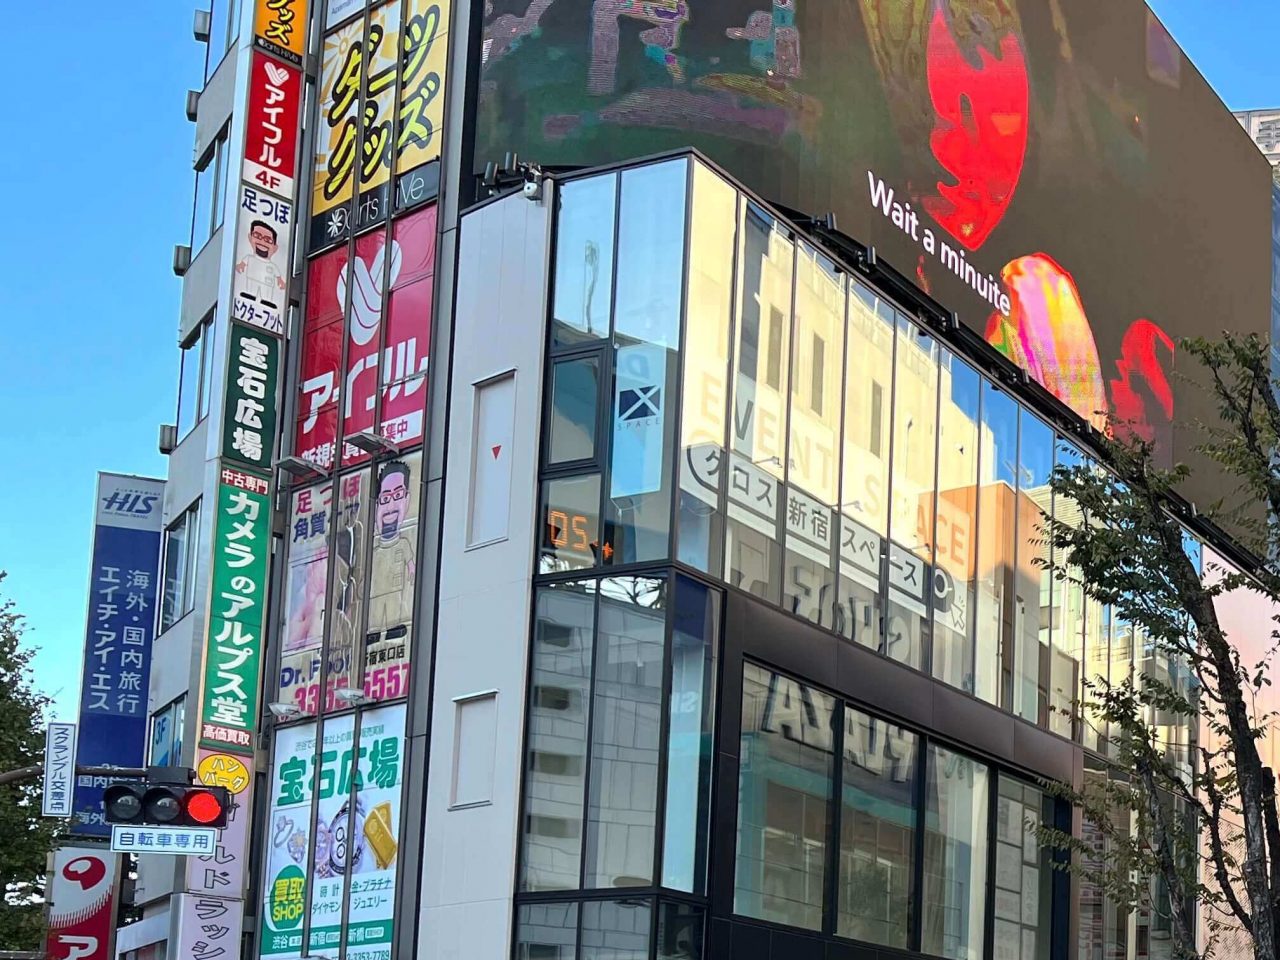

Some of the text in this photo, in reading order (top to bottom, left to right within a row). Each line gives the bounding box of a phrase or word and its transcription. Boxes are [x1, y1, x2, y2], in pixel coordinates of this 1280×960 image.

[259, 84, 286, 168] アイフル
[255, 170, 281, 189] 4F
[242, 189, 291, 225] 足つぼ
[867, 170, 1011, 317] Wait a minuite
[233, 298, 283, 334] ドクターフット
[233, 337, 269, 461] 宝石広場
[303, 337, 428, 435] アイフル
[616, 417, 661, 431] SPACE
[702, 371, 832, 490] EVENT
[222, 468, 269, 495] 中古専門
[102, 492, 159, 515] HIS
[705, 449, 918, 587] クロス新宿スペース
[210, 491, 260, 727] カメラのアルプス堂
[88, 566, 121, 711] エイチ・アイ・エス
[117, 569, 150, 714] 海外・国内旅行
[280, 664, 305, 689] Dr.
[202, 724, 250, 746] 高価買取
[49, 727, 70, 812] スクランブル交差点
[204, 769, 245, 791] バーグ
[212, 757, 239, 773] ハン
[277, 736, 400, 807] 宝石広場
[119, 831, 210, 850] 自転車専用
[274, 876, 304, 905] 買取
[353, 896, 388, 910] ジュエリー
[273, 904, 304, 921] SHOP
[312, 902, 341, 915] ダイヤモン
